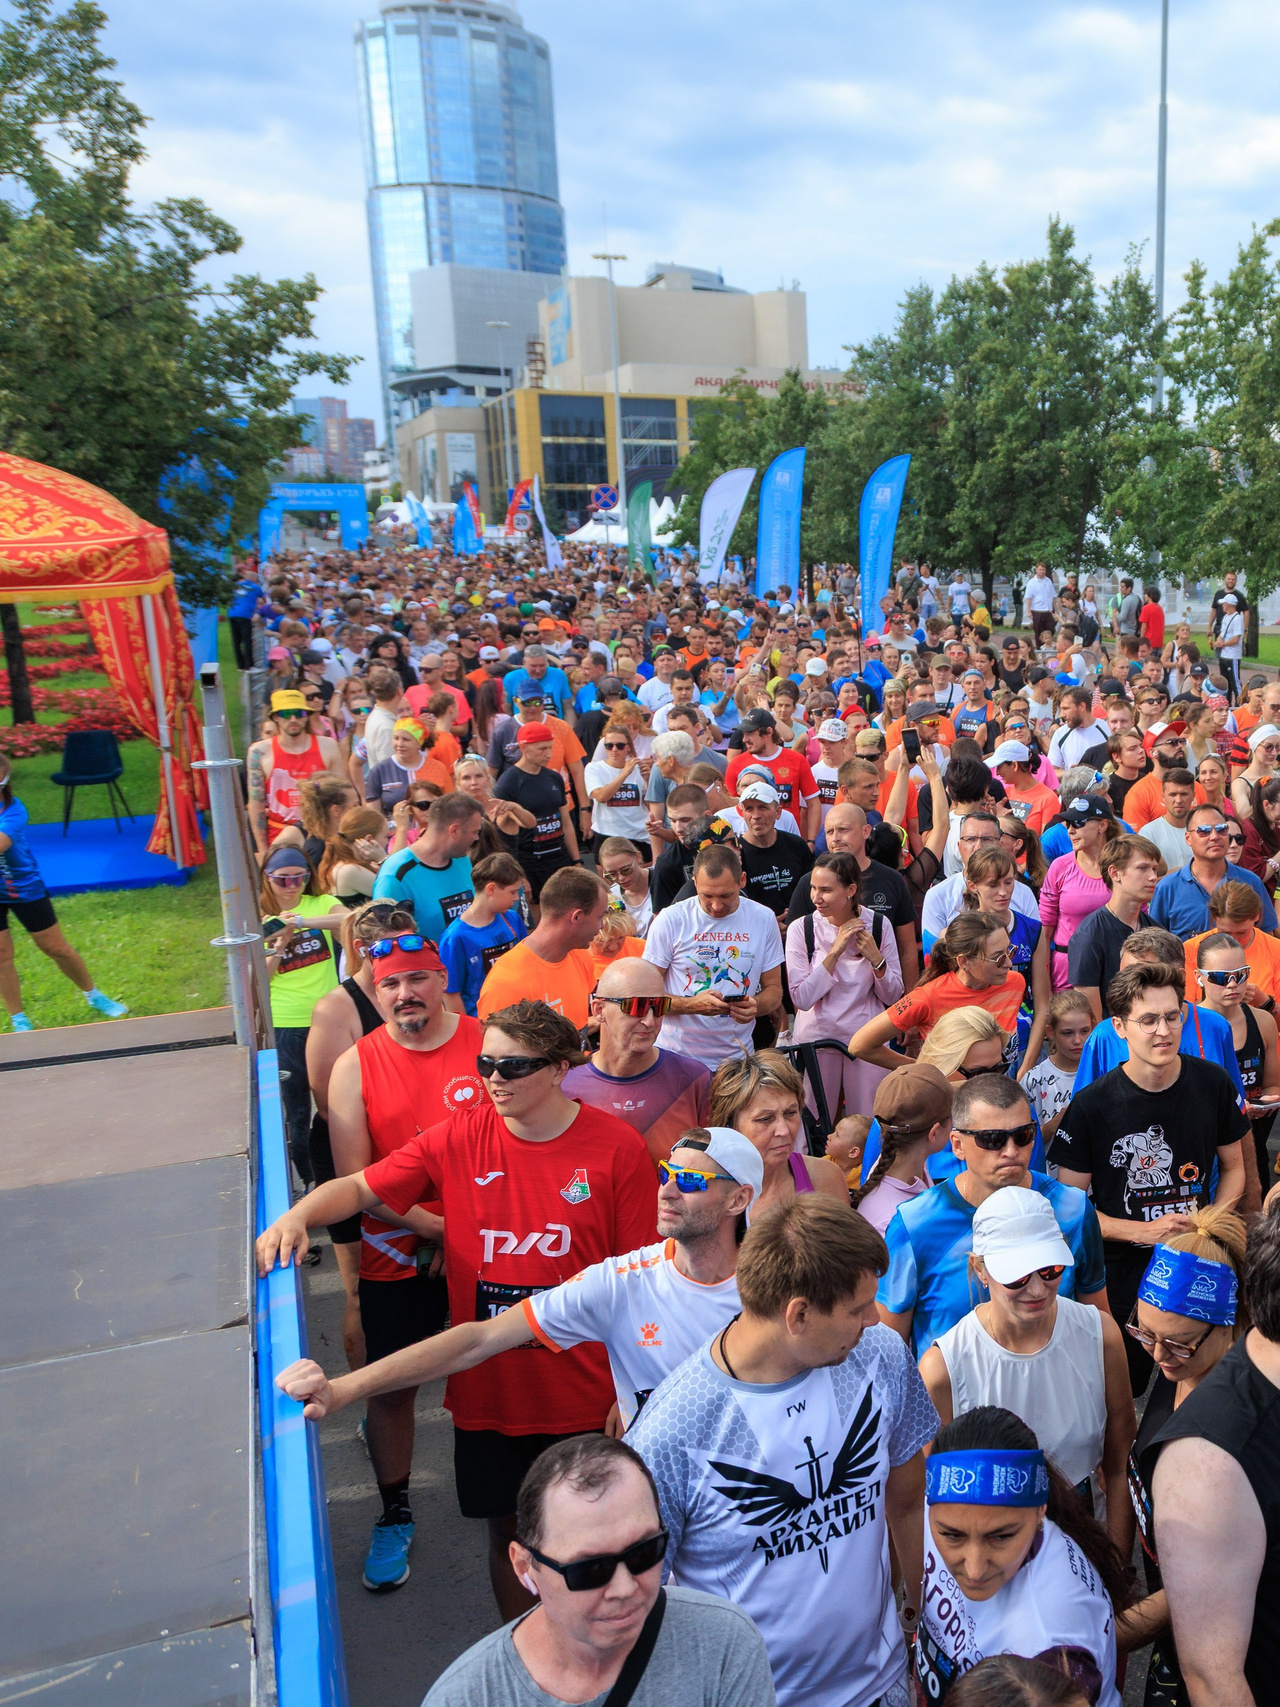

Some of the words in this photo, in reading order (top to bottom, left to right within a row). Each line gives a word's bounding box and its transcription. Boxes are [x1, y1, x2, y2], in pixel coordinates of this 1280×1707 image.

[536, 820, 561, 833] 15459
[693, 932, 750, 943] KENEBAS
[443, 1075, 483, 1093] сообщество
[751, 1482, 881, 1553] АРХАНГЕЛ
[764, 1502, 878, 1566] МИХАИЛ
